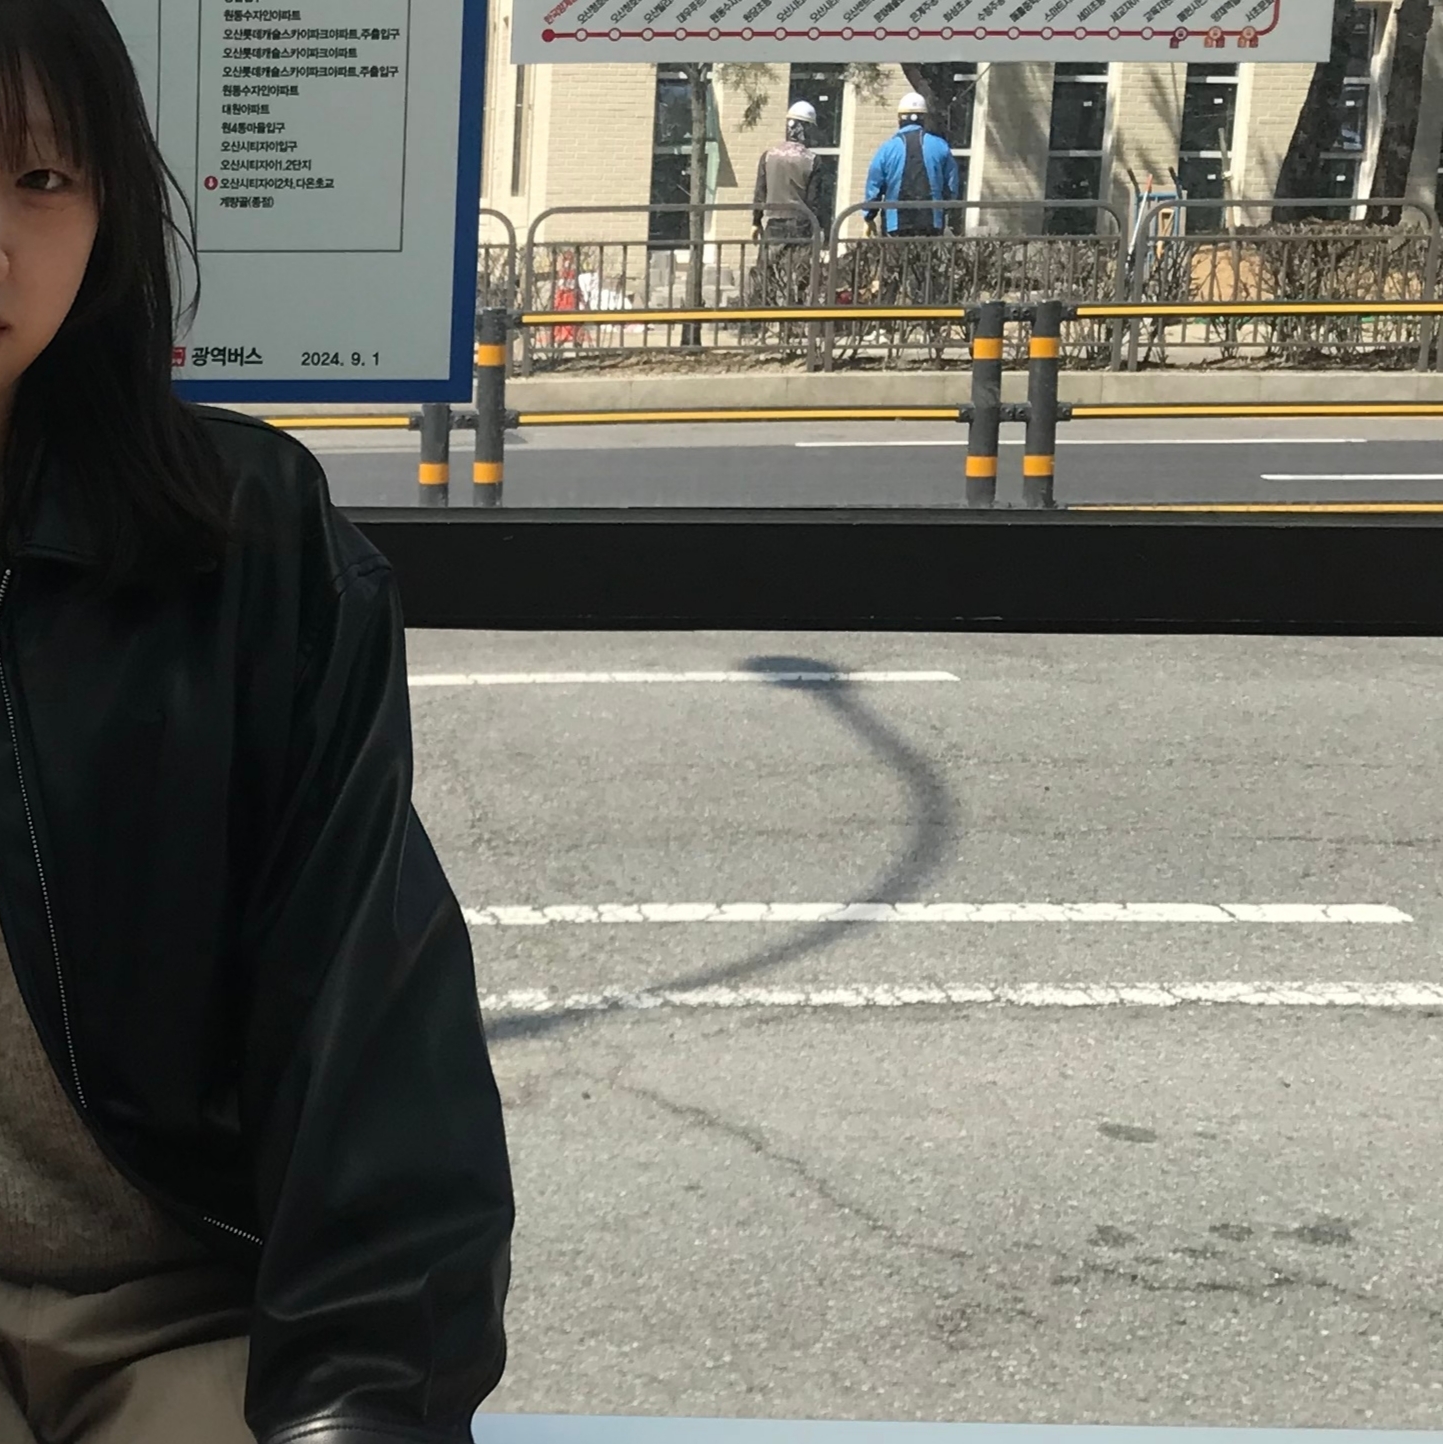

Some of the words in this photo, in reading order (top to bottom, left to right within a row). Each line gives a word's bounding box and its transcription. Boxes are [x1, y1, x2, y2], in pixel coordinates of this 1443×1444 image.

[191, 346, 263, 367] 광역버스
[301, 351, 344, 366] 2024.
[350, 351, 365, 366] 9.
[372, 351, 380, 366] 1
